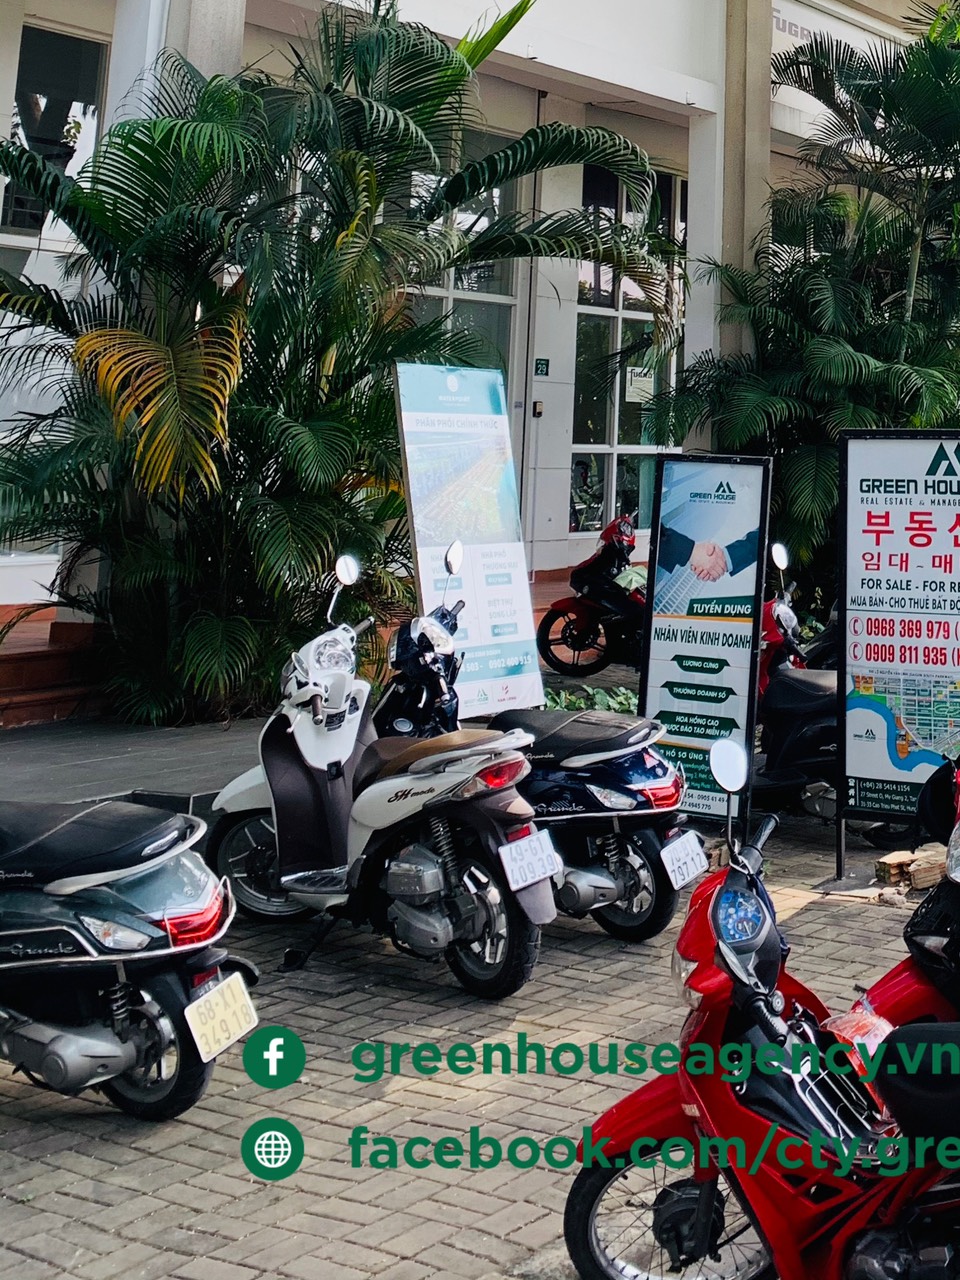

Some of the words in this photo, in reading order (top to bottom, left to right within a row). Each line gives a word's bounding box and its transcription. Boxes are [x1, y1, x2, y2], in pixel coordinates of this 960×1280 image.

[537, 364, 547, 375] 29
[859, 478, 918, 495] GREEN
[689, 492, 712, 500] GREEN
[713, 493, 736, 501] HOUSE
[860, 497, 879, 505] REAL
[884, 497, 913, 506] ESTATE
[860, 578, 882, 590] FOR
[885, 578, 912, 591] SALE
[922, 580, 946, 593] FOR
[692, 600, 722, 614] TUYỂN
[723, 604, 752, 616] DỤNG
[849, 595, 867, 608] MUA
[908, 594, 930, 610] THUÊ
[931, 593, 948, 611] BẤT
[653, 624, 679, 643] NHÂN
[680, 626, 698, 645] VIÊN
[700, 631, 721, 647] KINH
[721, 633, 752, 649] DOANH
[865, 617, 895, 637] 0968
[899, 619, 922, 639] 369
[926, 620, 951, 640] 979
[865, 643, 895, 663] 0909
[899, 645, 919, 664] 811
[923, 646, 948, 666] 935
[675, 715, 689, 723] HOA
[707, 719, 720, 727] CAO
[510, 853, 556, 887] 409.39
[670, 852, 706, 887] 797.12
